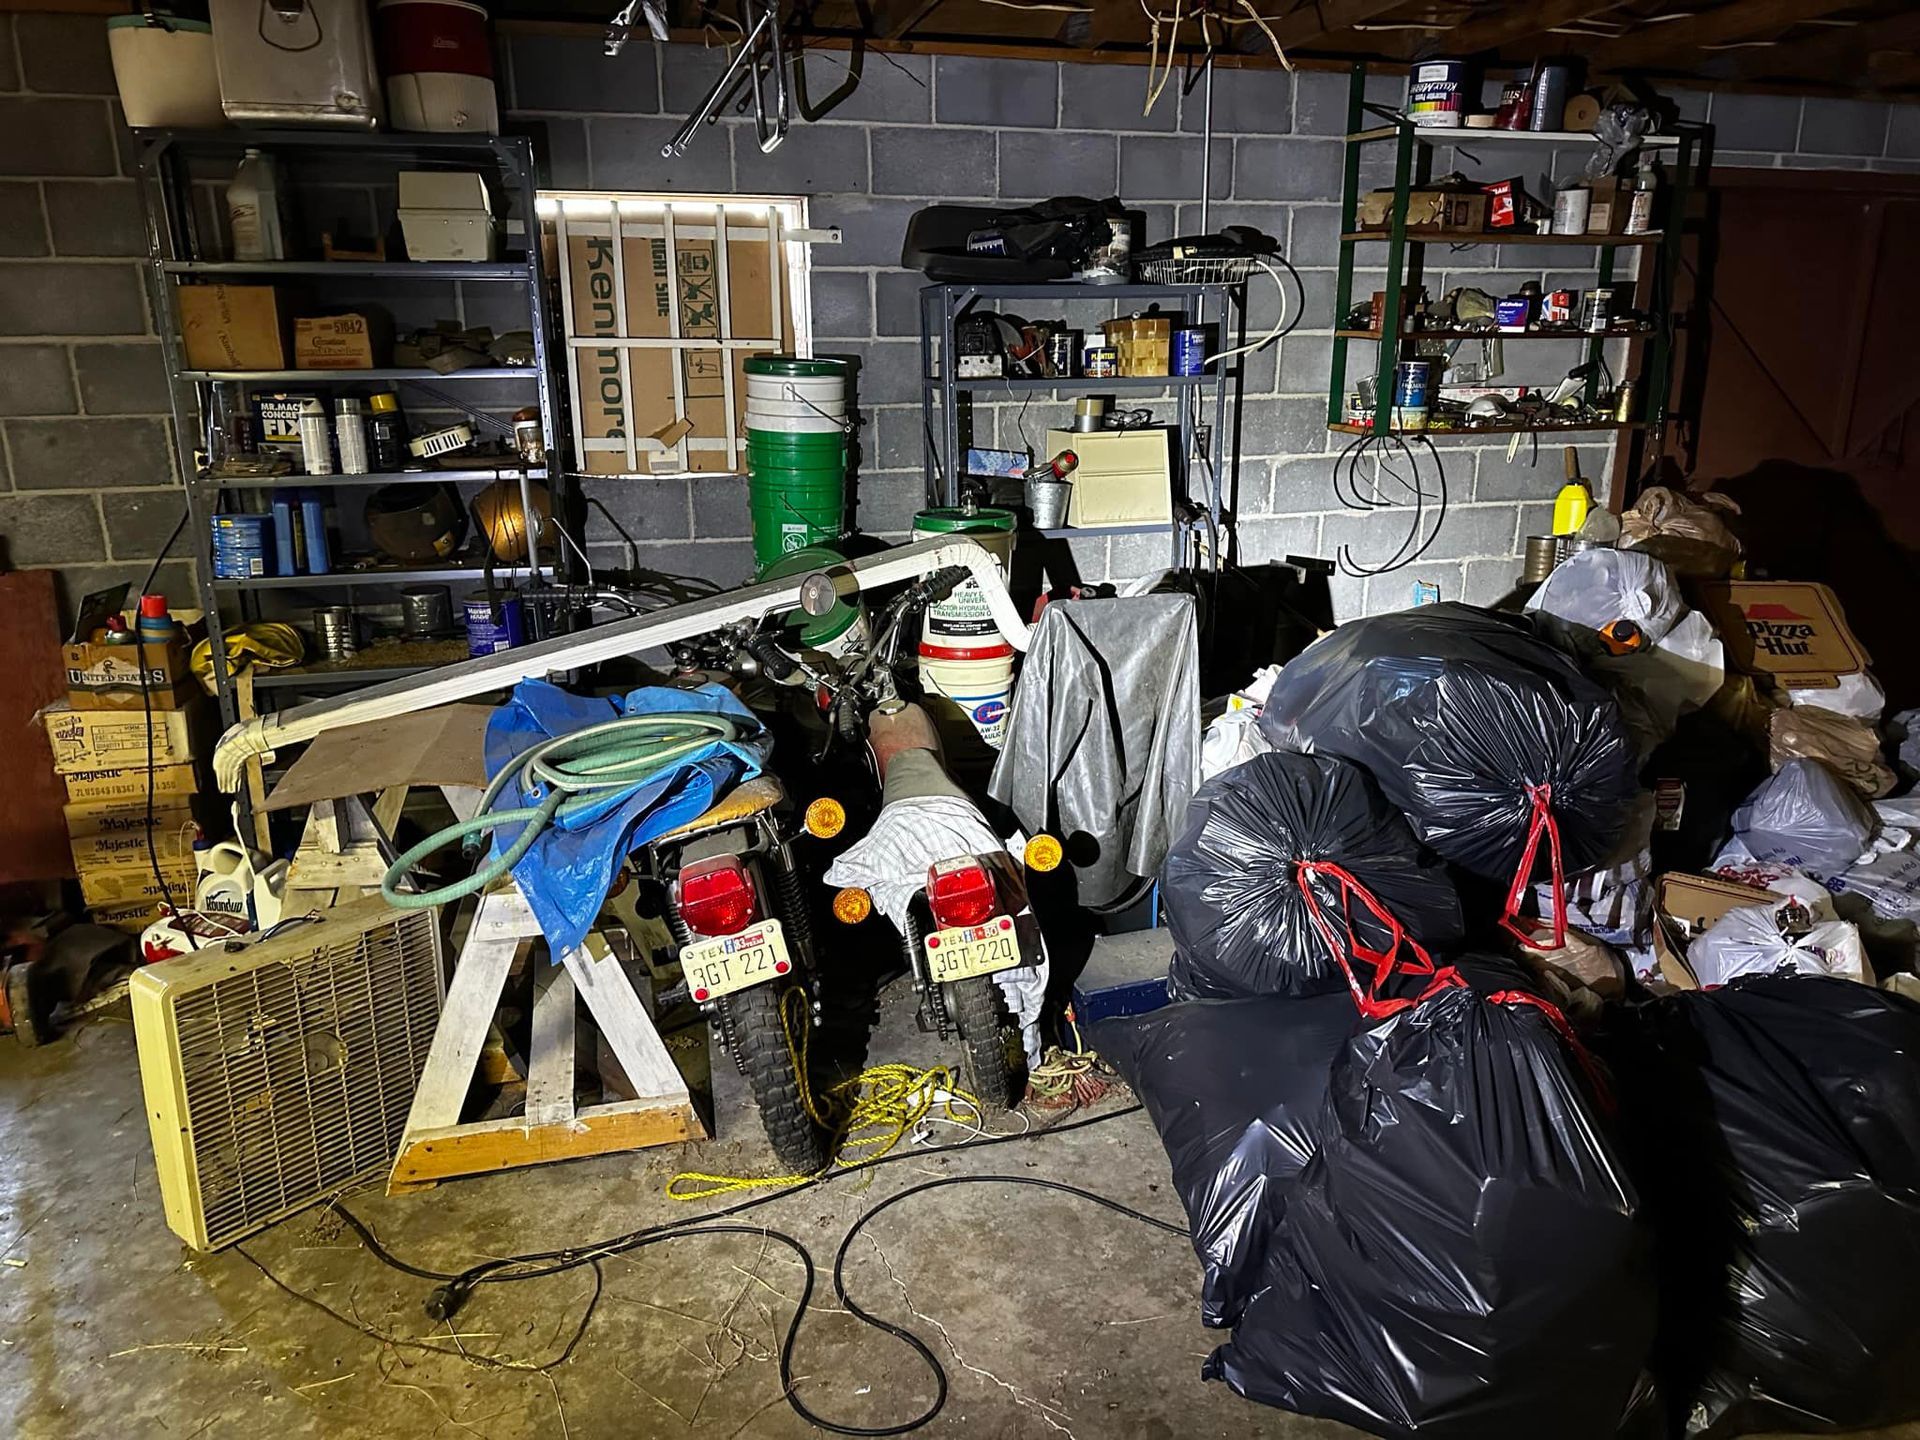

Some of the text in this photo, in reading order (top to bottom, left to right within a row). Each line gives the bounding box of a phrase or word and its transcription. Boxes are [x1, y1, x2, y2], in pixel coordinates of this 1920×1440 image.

[586, 236, 626, 454] Kenmore
[262, 418, 300, 435] FIX
[1745, 621, 1817, 639] Pizza
[1756, 637, 1812, 655] Hut
[117, 669, 165, 683] STAES
[69, 768, 122, 783] Majestic
[96, 838, 145, 852] Majestic
[143, 881, 192, 895] Majstic
[205, 896, 243, 913] Roundup
[935, 938, 1012, 973] 3GT 220
[693, 959, 731, 988] 3GT
[740, 944, 777, 975] 221
